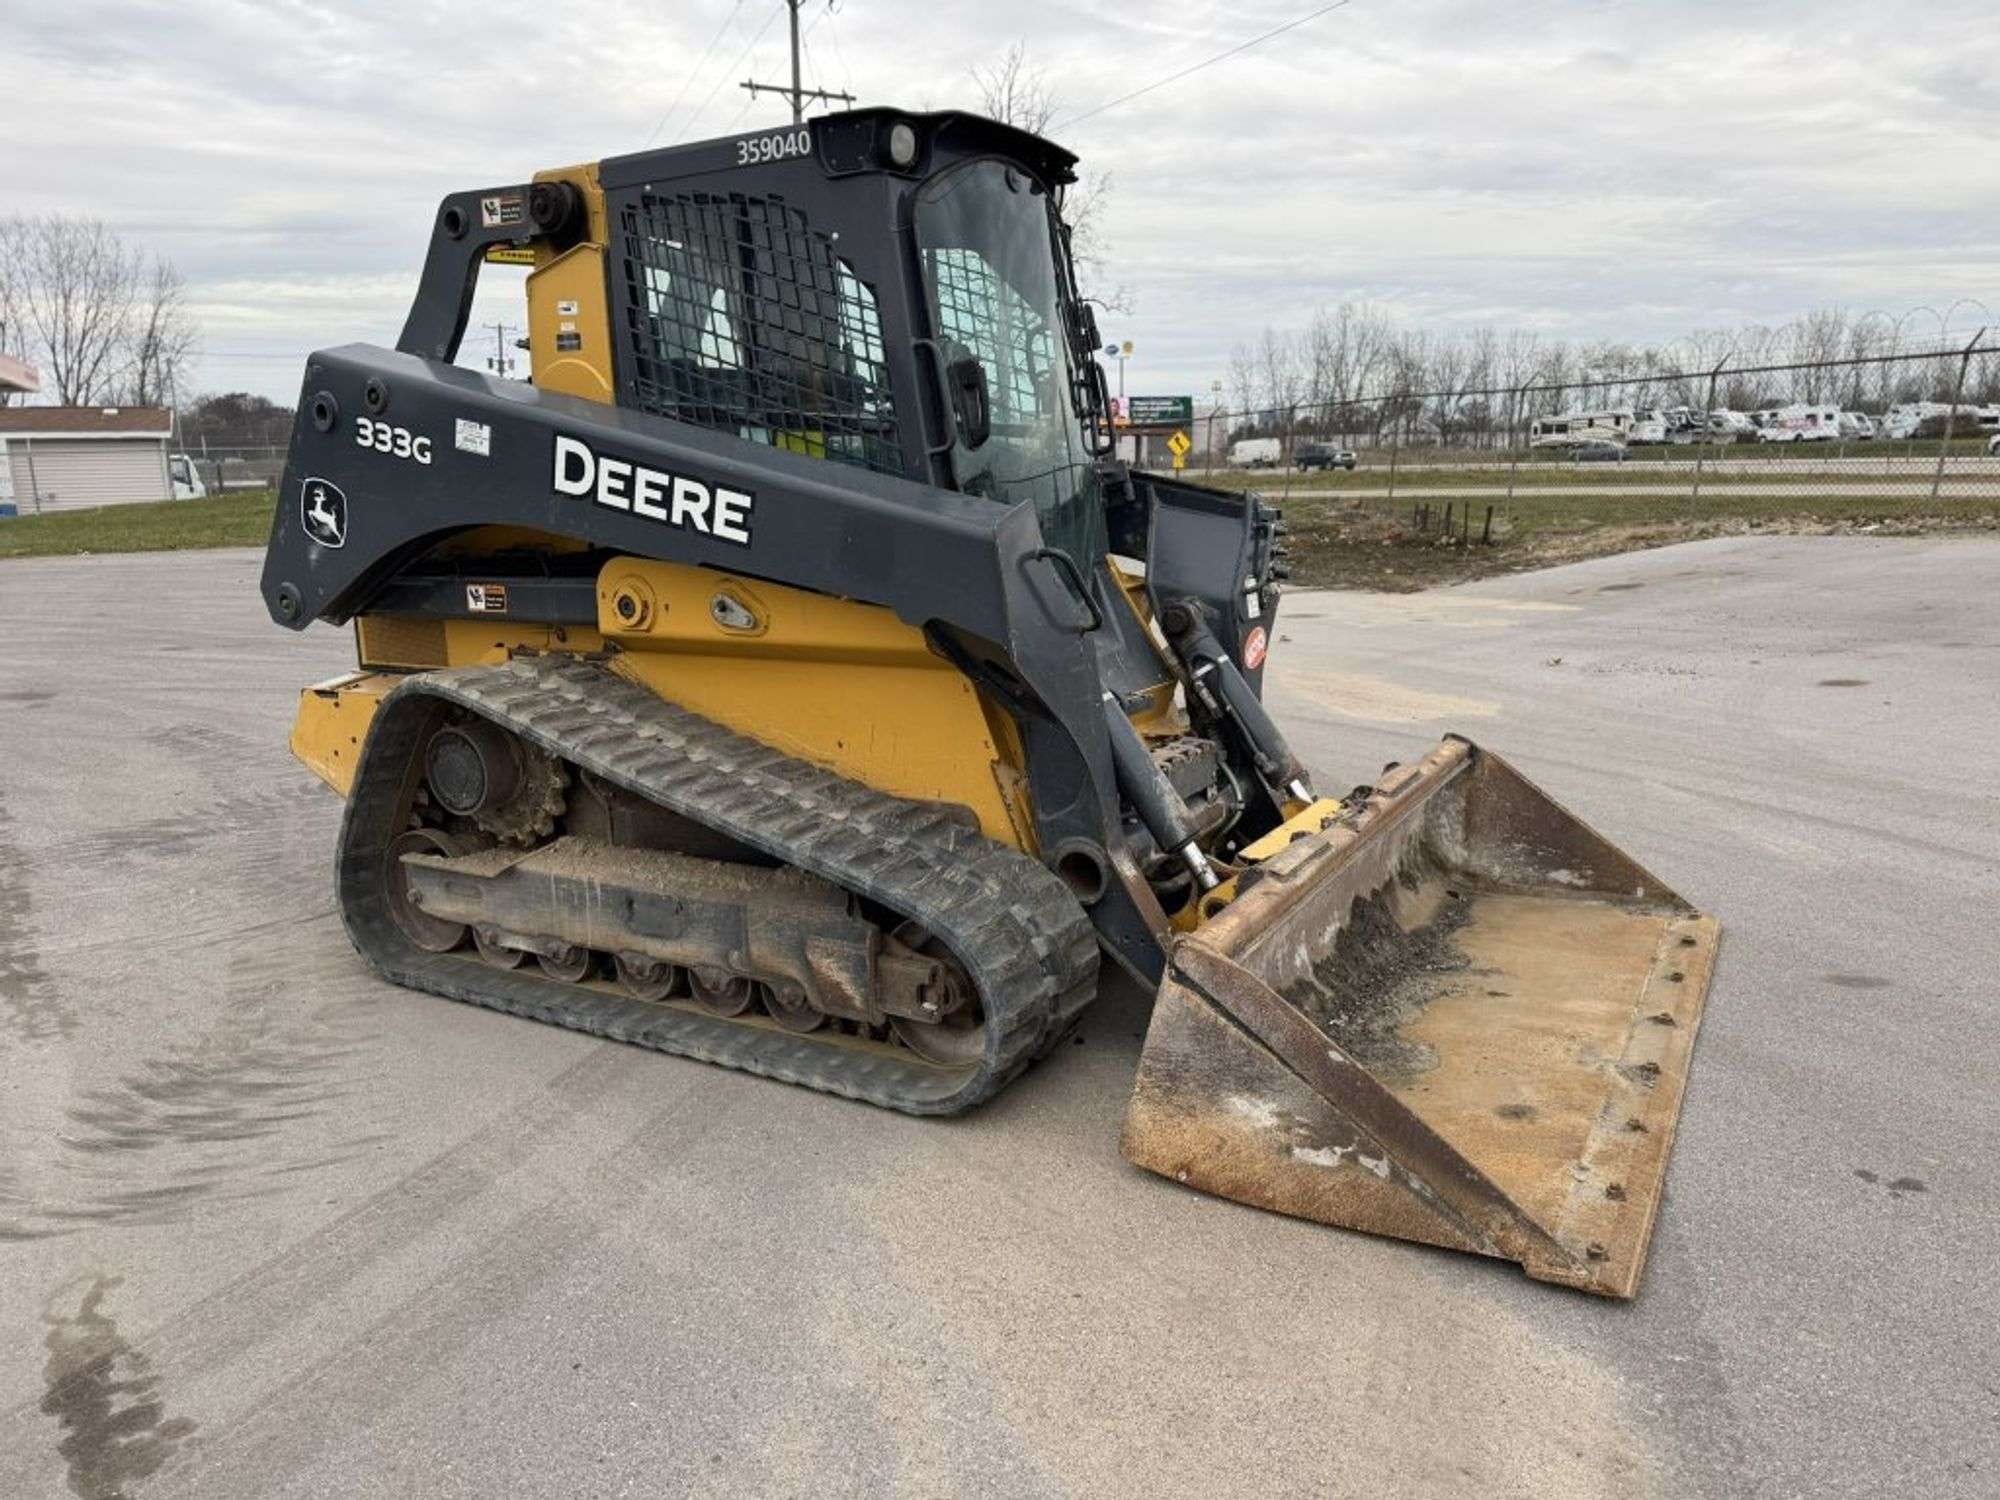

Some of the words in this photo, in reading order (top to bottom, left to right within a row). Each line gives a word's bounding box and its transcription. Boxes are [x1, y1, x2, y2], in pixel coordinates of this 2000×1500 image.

[736, 131, 811, 165] 359040
[356, 417, 431, 464] 333G
[554, 435, 751, 543] DEERE
